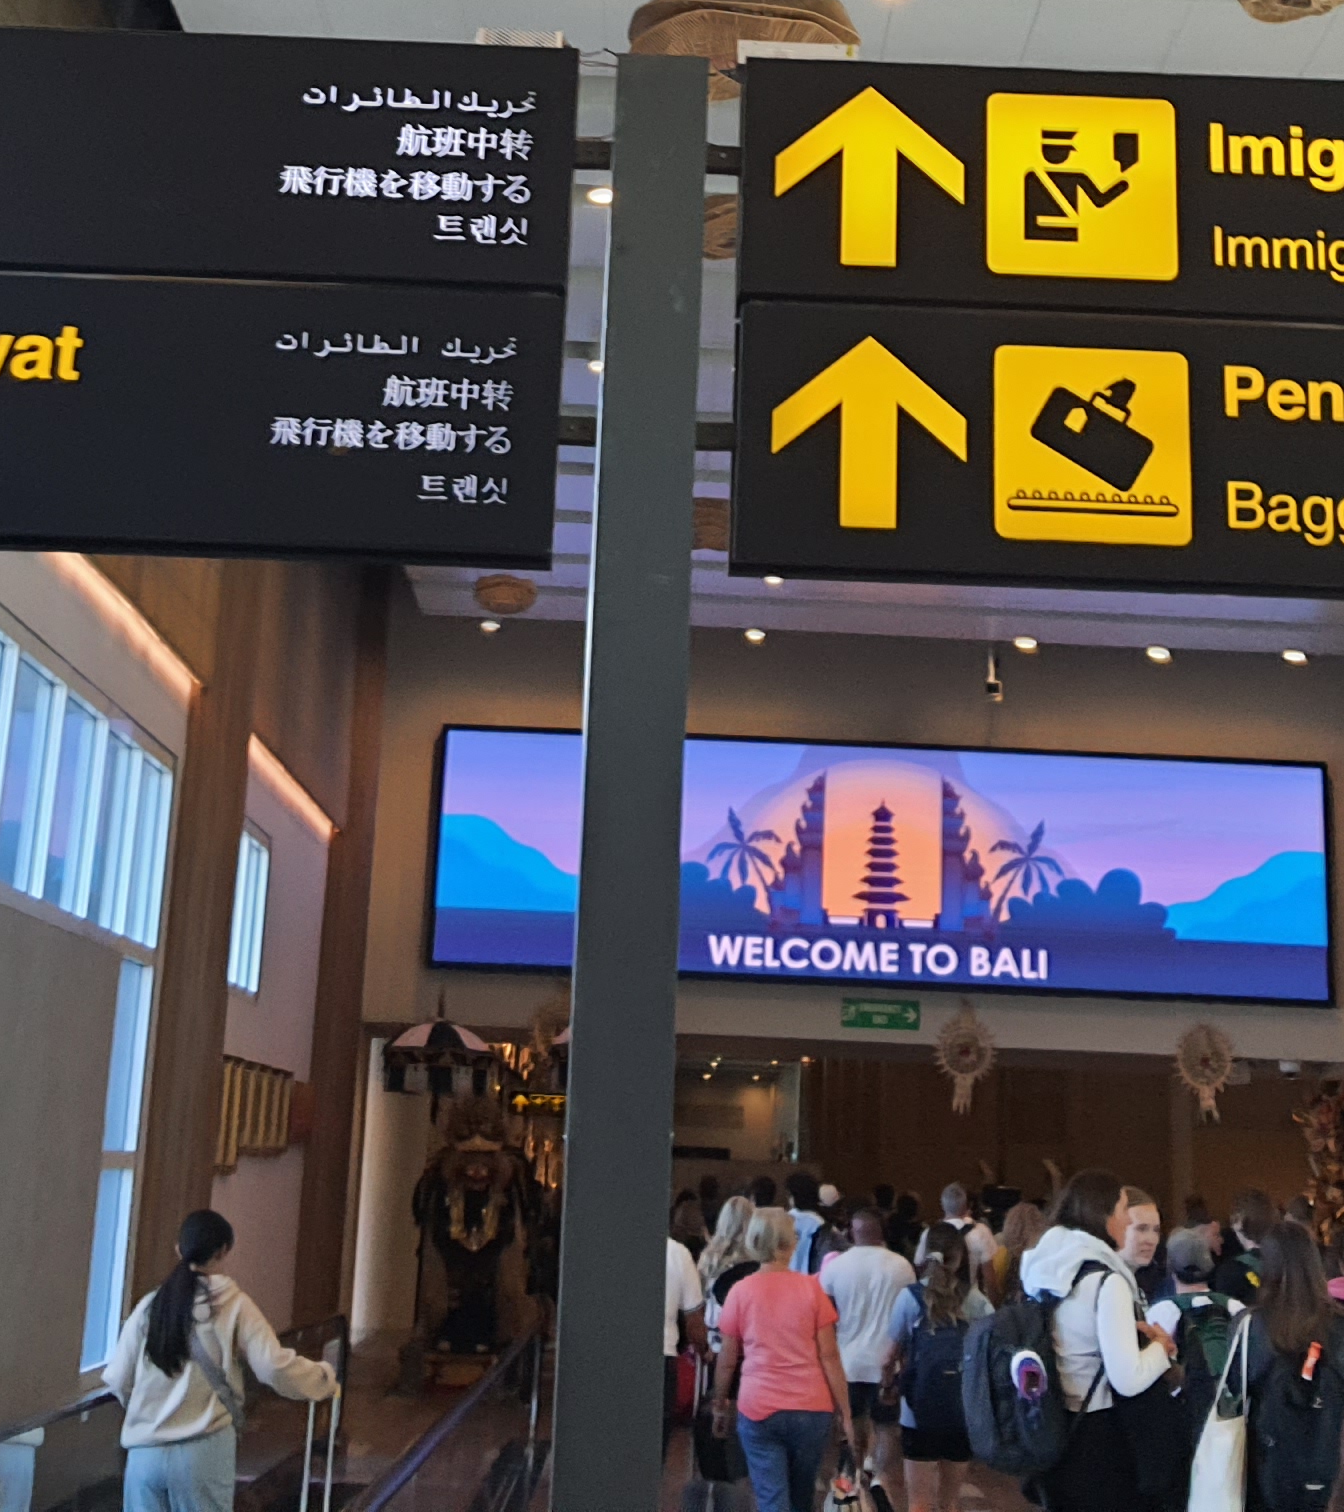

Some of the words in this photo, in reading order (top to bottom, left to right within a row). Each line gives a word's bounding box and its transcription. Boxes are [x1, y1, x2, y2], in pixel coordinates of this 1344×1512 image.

[395, 123, 534, 161] 航班中转
[278, 165, 531, 204] 飛行機を移動する
[432, 214, 528, 246] 트랜싯
[381, 374, 514, 411] 航班中转
[269, 416, 511, 454] 飛行機を移動する
[417, 473, 508, 505] 트랜싯
[707, 933, 899, 974] WELCOME
[907, 942, 958, 977] TO
[969, 945, 1048, 981] BALI
